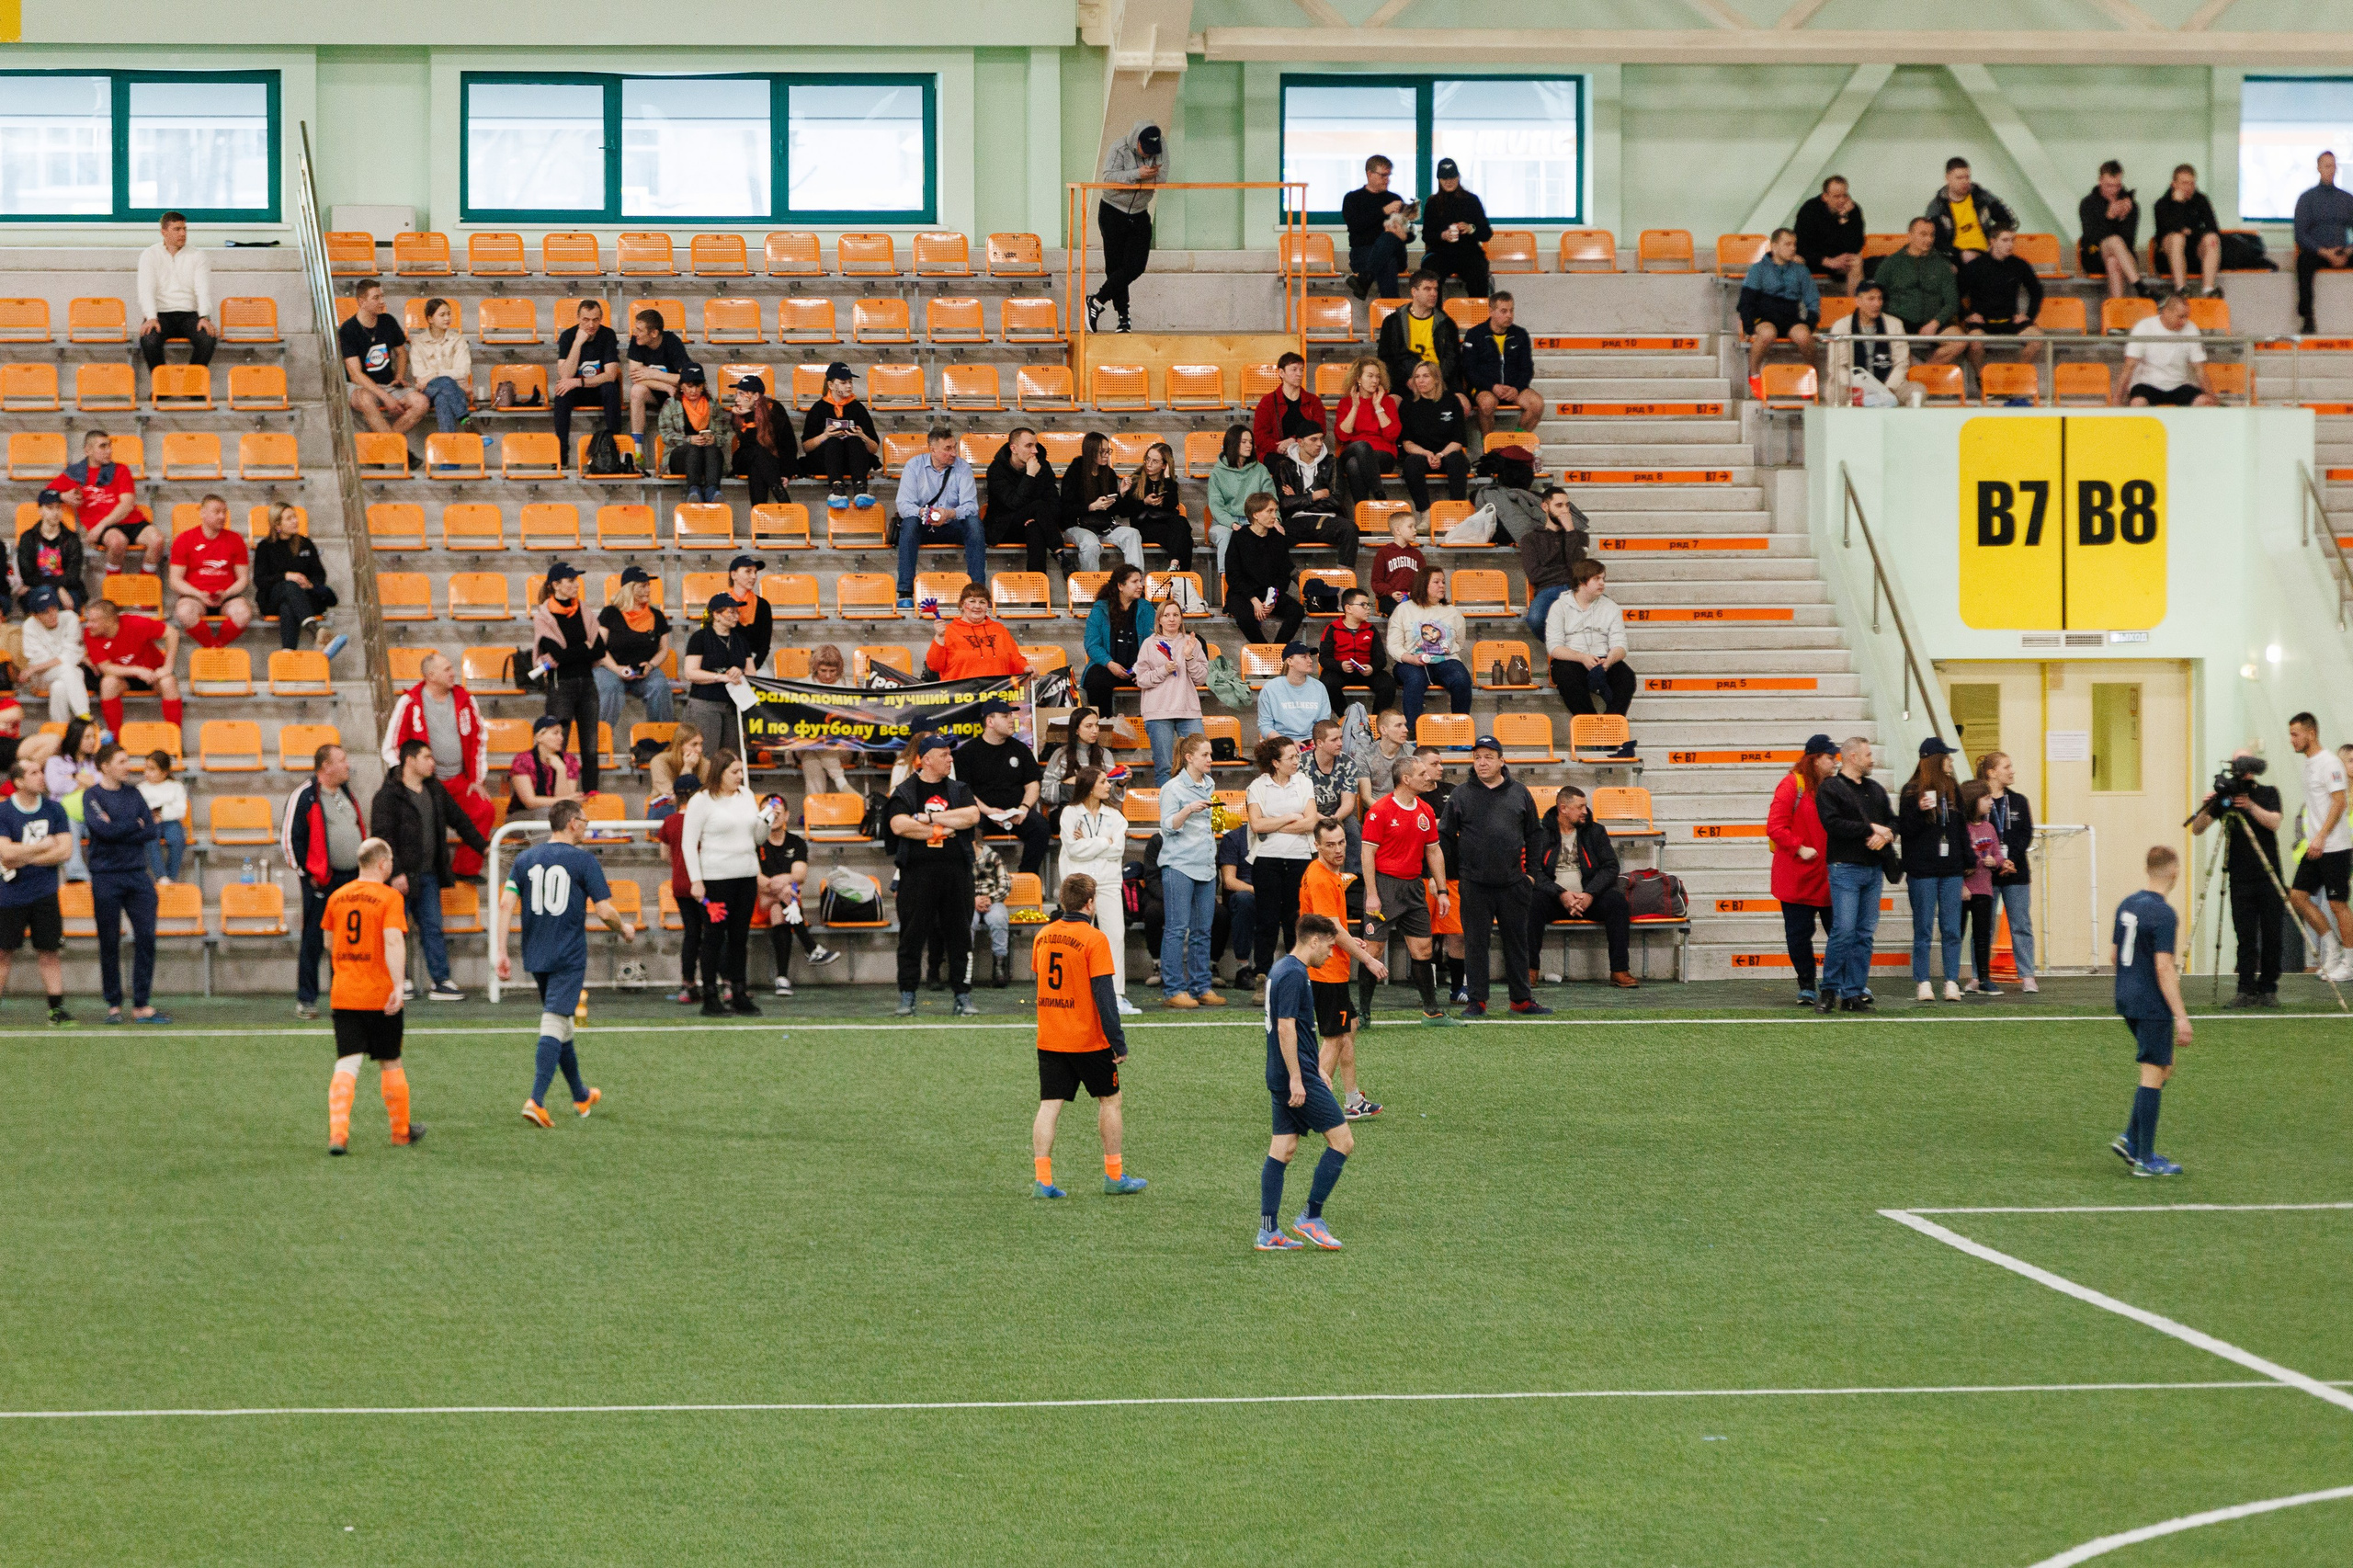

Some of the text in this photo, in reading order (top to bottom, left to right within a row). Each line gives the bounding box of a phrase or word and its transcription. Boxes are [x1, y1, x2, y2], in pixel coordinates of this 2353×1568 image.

[1648, 404, 1654, 413] 9
[1657, 472, 1663, 480] 8
[1977, 479, 2157, 546] B7 B8
[1693, 540, 1699, 548] 7
[1388, 556, 1418, 572] ORIGINAL
[1694, 611, 1713, 619] ряд
[1716, 609, 1722, 618] 6
[1717, 681, 1736, 689] ряд
[751, 687, 861, 706] ралдоломит
[883, 690, 950, 709] лучший
[954, 692, 974, 703] во
[1281, 701, 1318, 710] WELLNESS
[749, 718, 764, 734] И
[767, 722, 790, 734] по
[793, 719, 875, 739] футболу
[880, 725, 911, 735] все
[1741, 754, 1761, 762] ряд
[528, 863, 571, 916] 10
[347, 910, 361, 944] 9
[1048, 951, 1063, 991] 5
[1339, 1011, 1347, 1026] 7
